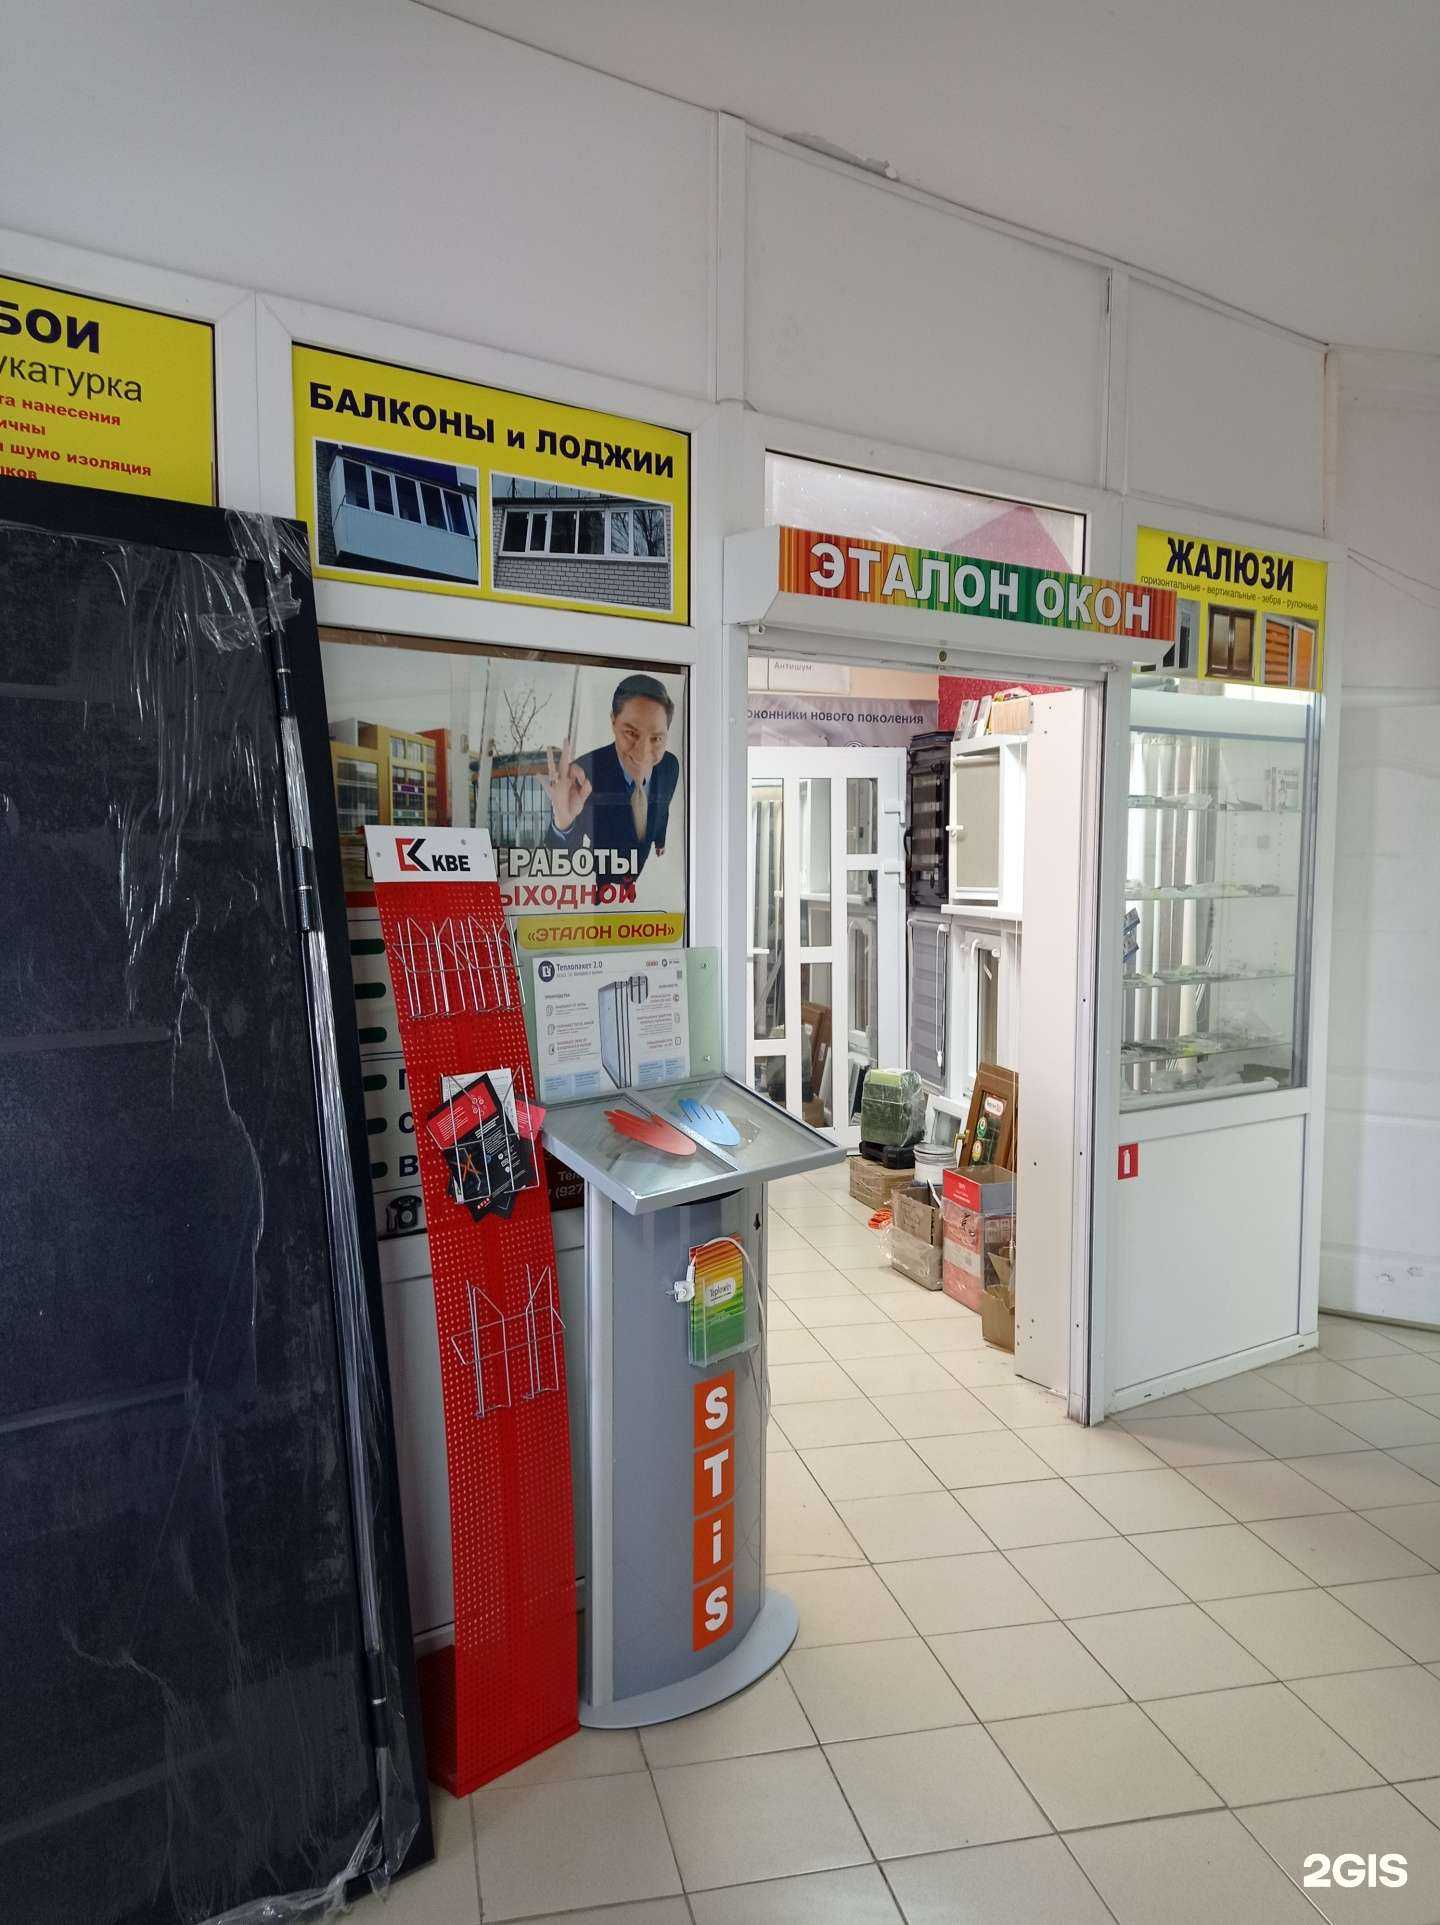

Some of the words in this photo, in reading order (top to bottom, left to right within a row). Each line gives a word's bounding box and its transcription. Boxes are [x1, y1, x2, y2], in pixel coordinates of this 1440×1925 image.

[22, 399, 121, 427] нанесения
[310, 381, 495, 444] БАЛКОНЫ
[507, 429, 525, 450] и
[535, 429, 674, 479] ЛОДЖИИ
[11, 442, 60, 462] шумо
[67, 452, 152, 477] изоляция
[1166, 537, 1294, 593] ЖАЛЮЗИ
[809, 542, 1019, 614] ЭТАЛОН
[1035, 578, 1151, 633] ОКОН
[1140, 576, 1201, 592] горизонтальные
[1207, 586, 1257, 601] вертикальные
[811, 711, 854, 723] нового
[857, 713, 924, 725] поколения
[431, 853, 471, 872] KBE
[508, 847, 639, 878] РАБОТЫ
[500, 878, 637, 910] ЫХОДНОЙ
[527, 924, 612, 943] «ЭТАЛОН
[618, 922, 675, 940] ОКОН»
